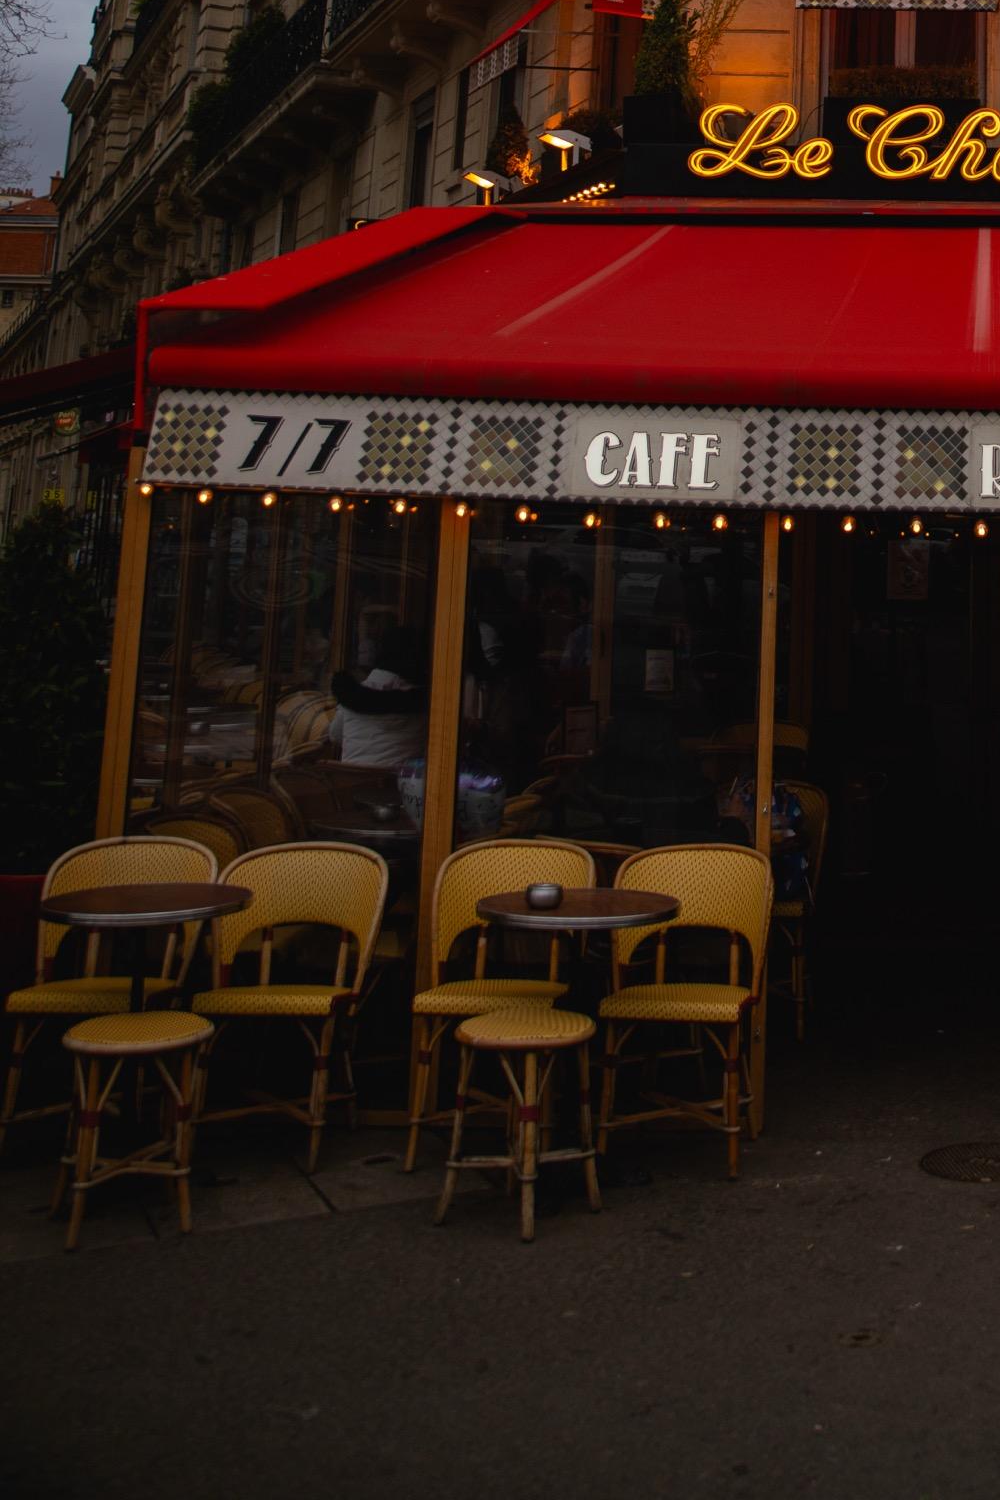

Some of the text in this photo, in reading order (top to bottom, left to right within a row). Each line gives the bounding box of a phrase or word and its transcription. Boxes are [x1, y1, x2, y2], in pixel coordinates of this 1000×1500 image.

[687, 102, 835, 181] Le
[237, 414, 353, 477] 7/7
[584, 430, 722, 491] CAFE
